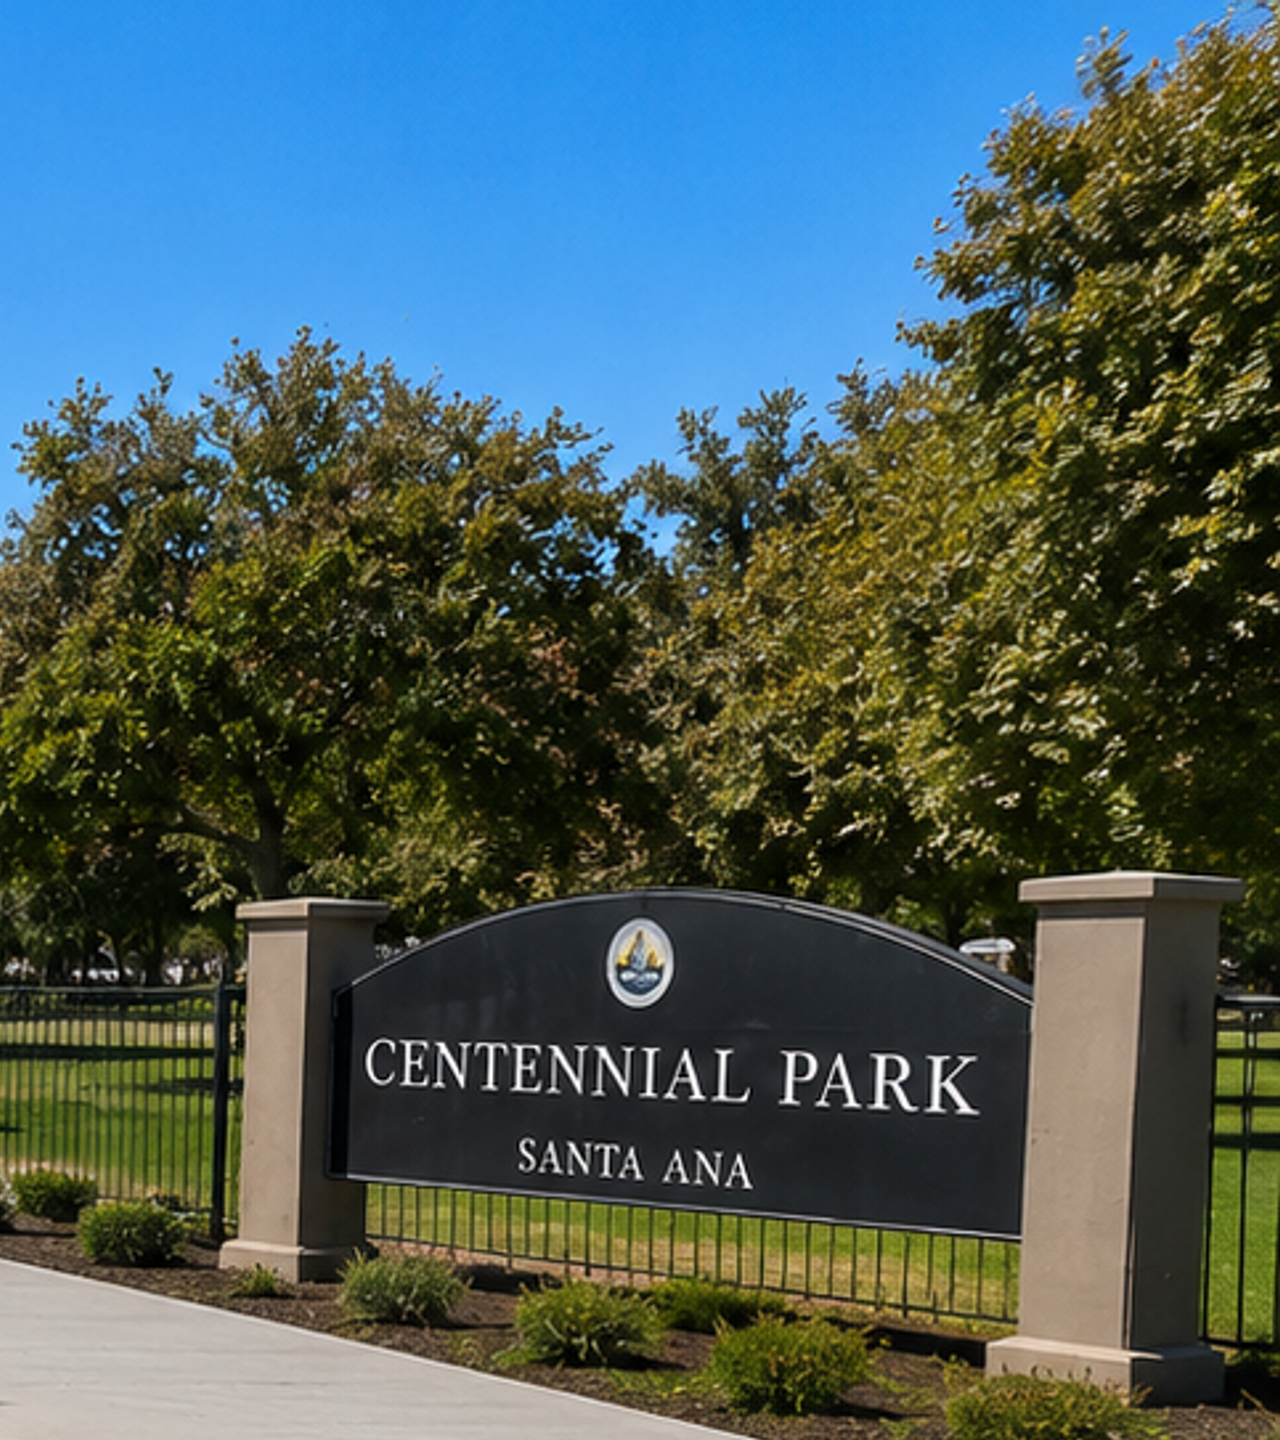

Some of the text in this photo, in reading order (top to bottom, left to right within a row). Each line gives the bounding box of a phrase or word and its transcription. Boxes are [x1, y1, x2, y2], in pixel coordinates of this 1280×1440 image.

[365, 1038, 980, 1116] CENTENNIAL PARK
[518, 1137, 753, 1190] SANTA ANA
